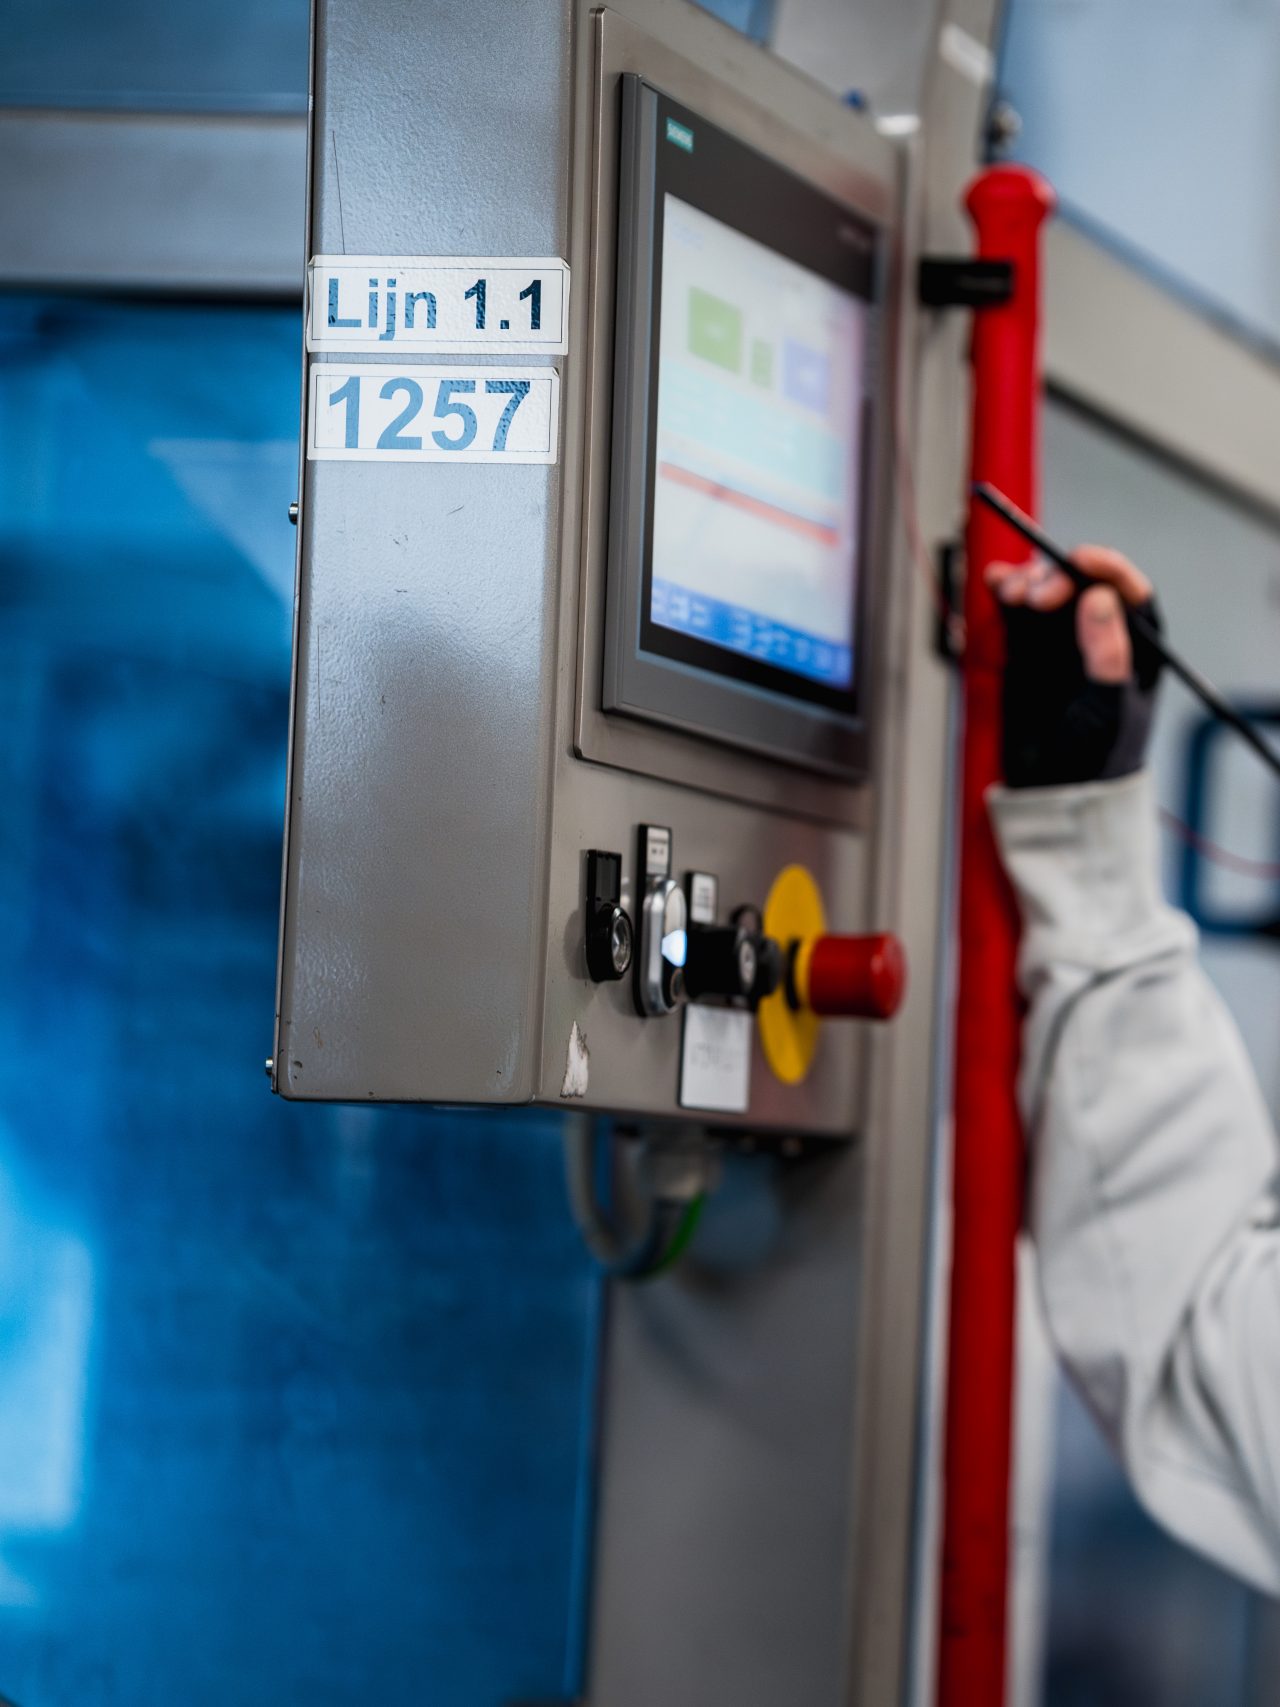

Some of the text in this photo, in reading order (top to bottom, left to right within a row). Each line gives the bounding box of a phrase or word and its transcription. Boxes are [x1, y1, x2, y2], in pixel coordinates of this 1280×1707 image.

[328, 278, 542, 341] Lijn 1.1
[329, 376, 531, 452] 1257
